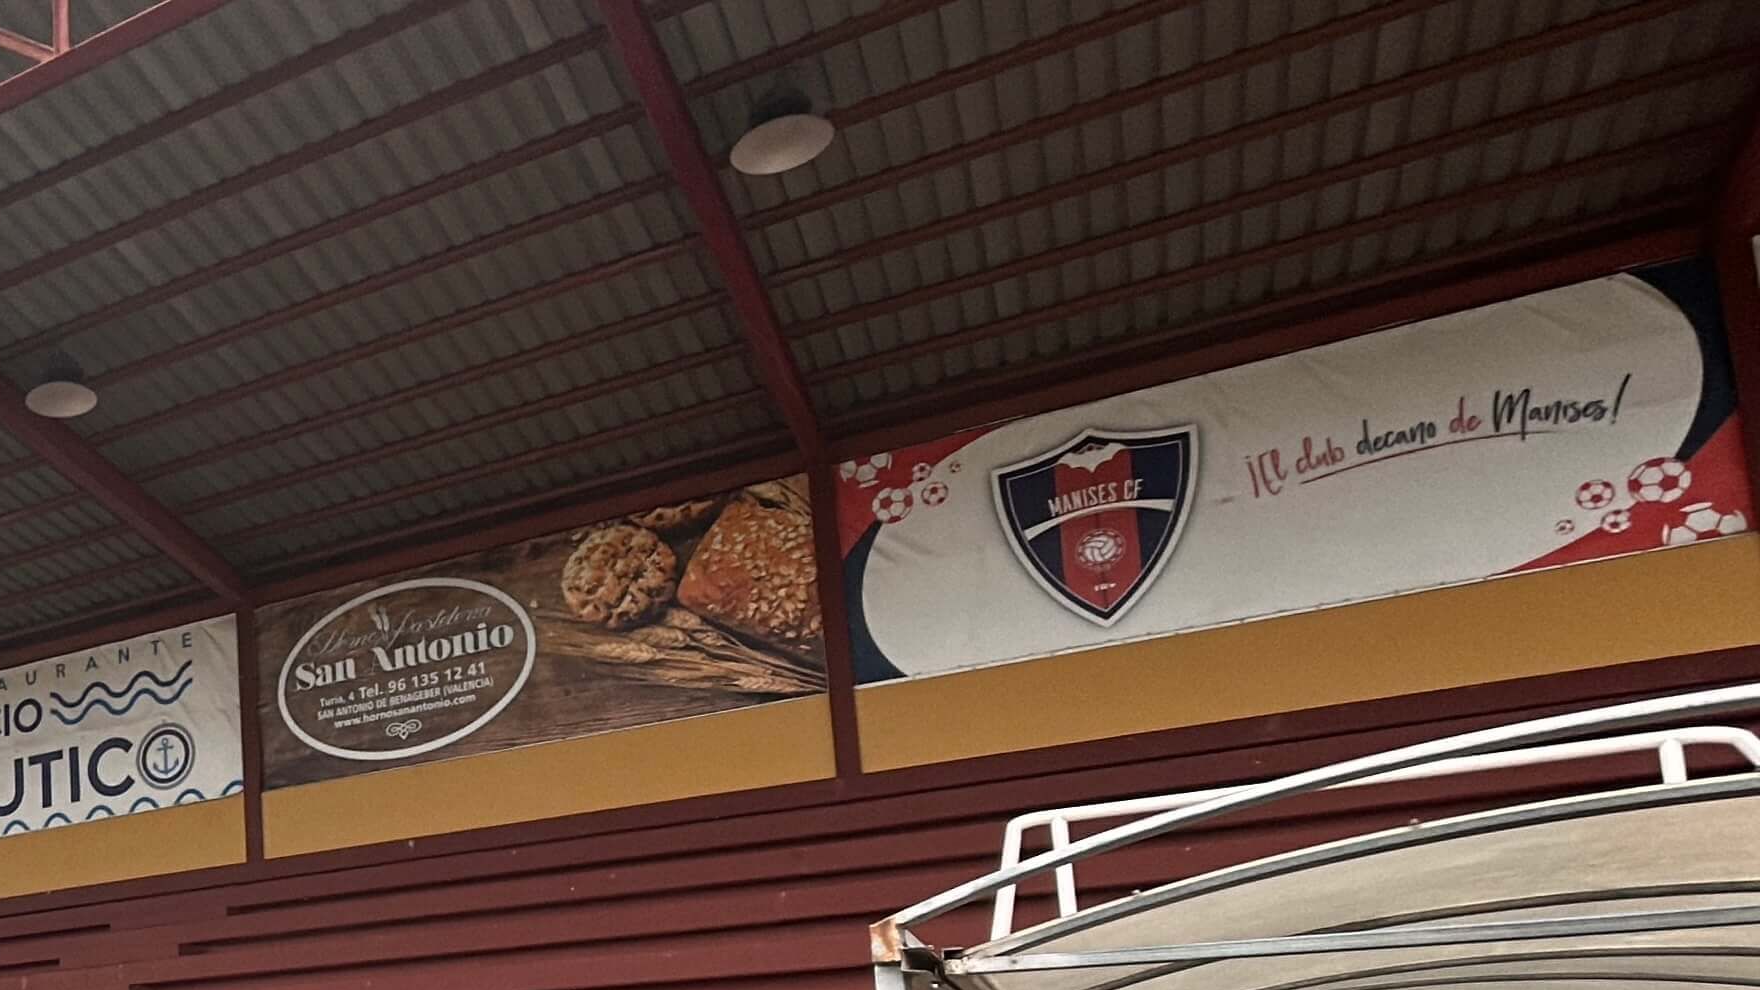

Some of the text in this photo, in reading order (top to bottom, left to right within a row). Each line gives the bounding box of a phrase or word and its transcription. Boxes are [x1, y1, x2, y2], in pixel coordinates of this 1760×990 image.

[1295, 437, 1345, 475] club
[1356, 419, 1437, 456] decano
[1448, 397, 1483, 435] de
[1492, 373, 1632, 441] Manises!
[1047, 478, 1144, 517] MANISES CF
[294, 622, 515, 691] San Antonio
[358, 682, 384, 699] Tel.
[388, 678, 407, 694] 96
[411, 671, 440, 689] 135
[444, 666, 463, 682] 12
[467, 661, 486, 677] 41
